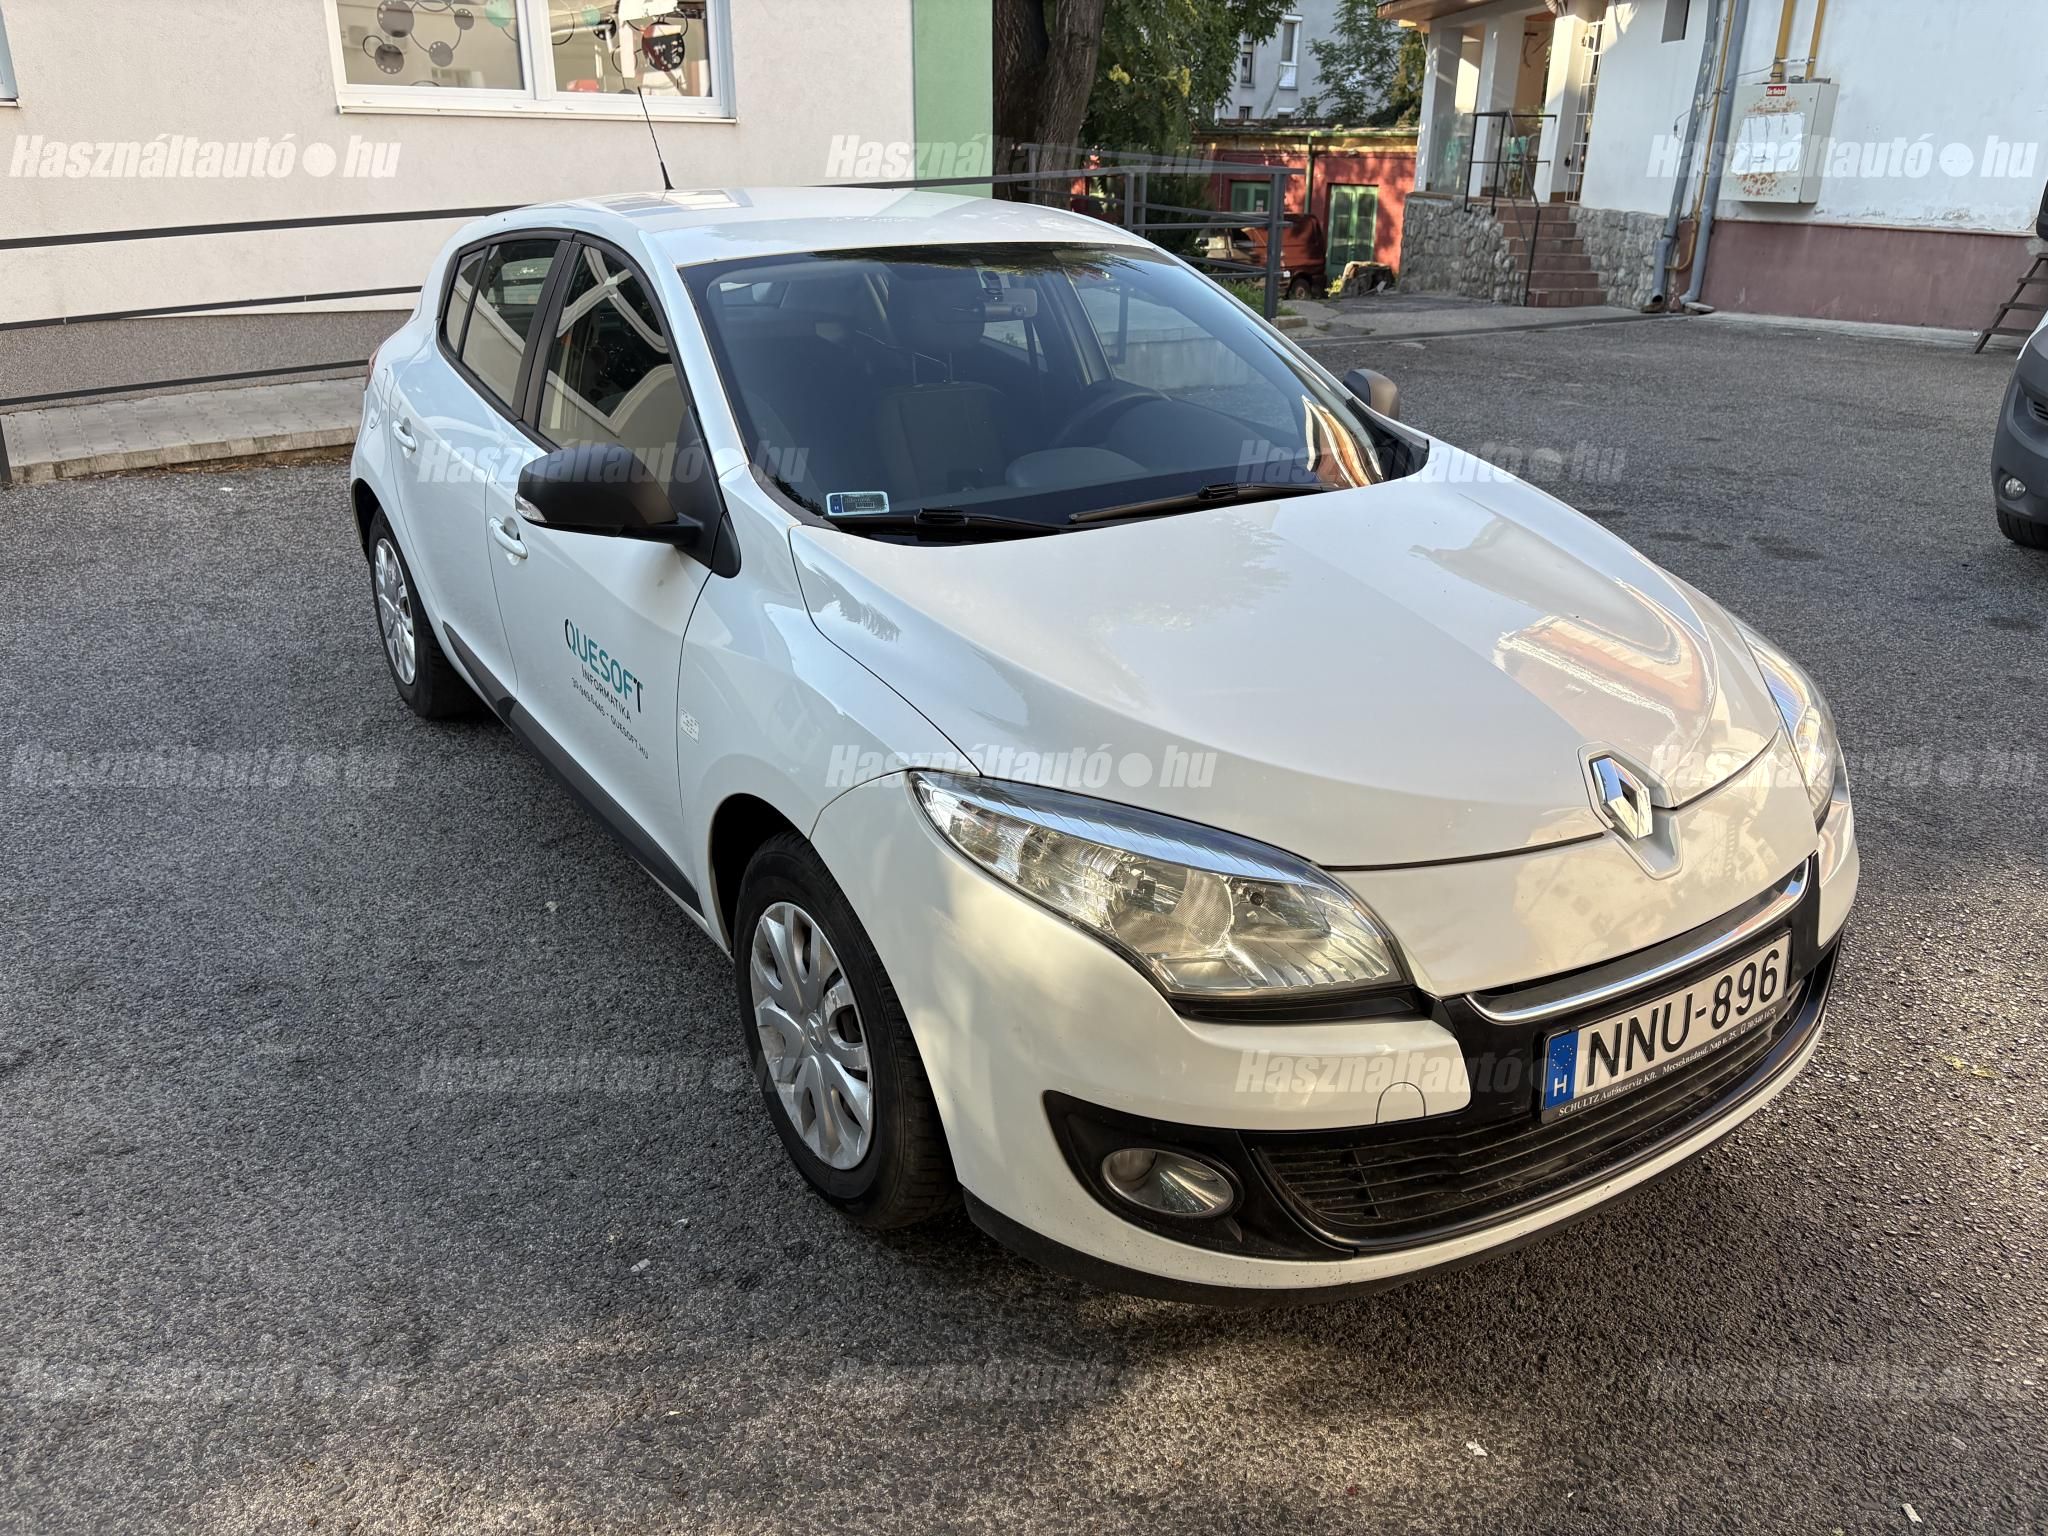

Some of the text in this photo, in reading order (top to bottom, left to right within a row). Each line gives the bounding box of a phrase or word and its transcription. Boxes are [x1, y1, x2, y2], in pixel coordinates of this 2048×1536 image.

[565, 619, 643, 713] QUESOFT
[581, 663, 632, 723] INFORMATIKA
[1587, 949, 1779, 1087] NNU-896
[1553, 1074, 1568, 1097] H
[1558, 1094, 1600, 1116] SCHULTZ
